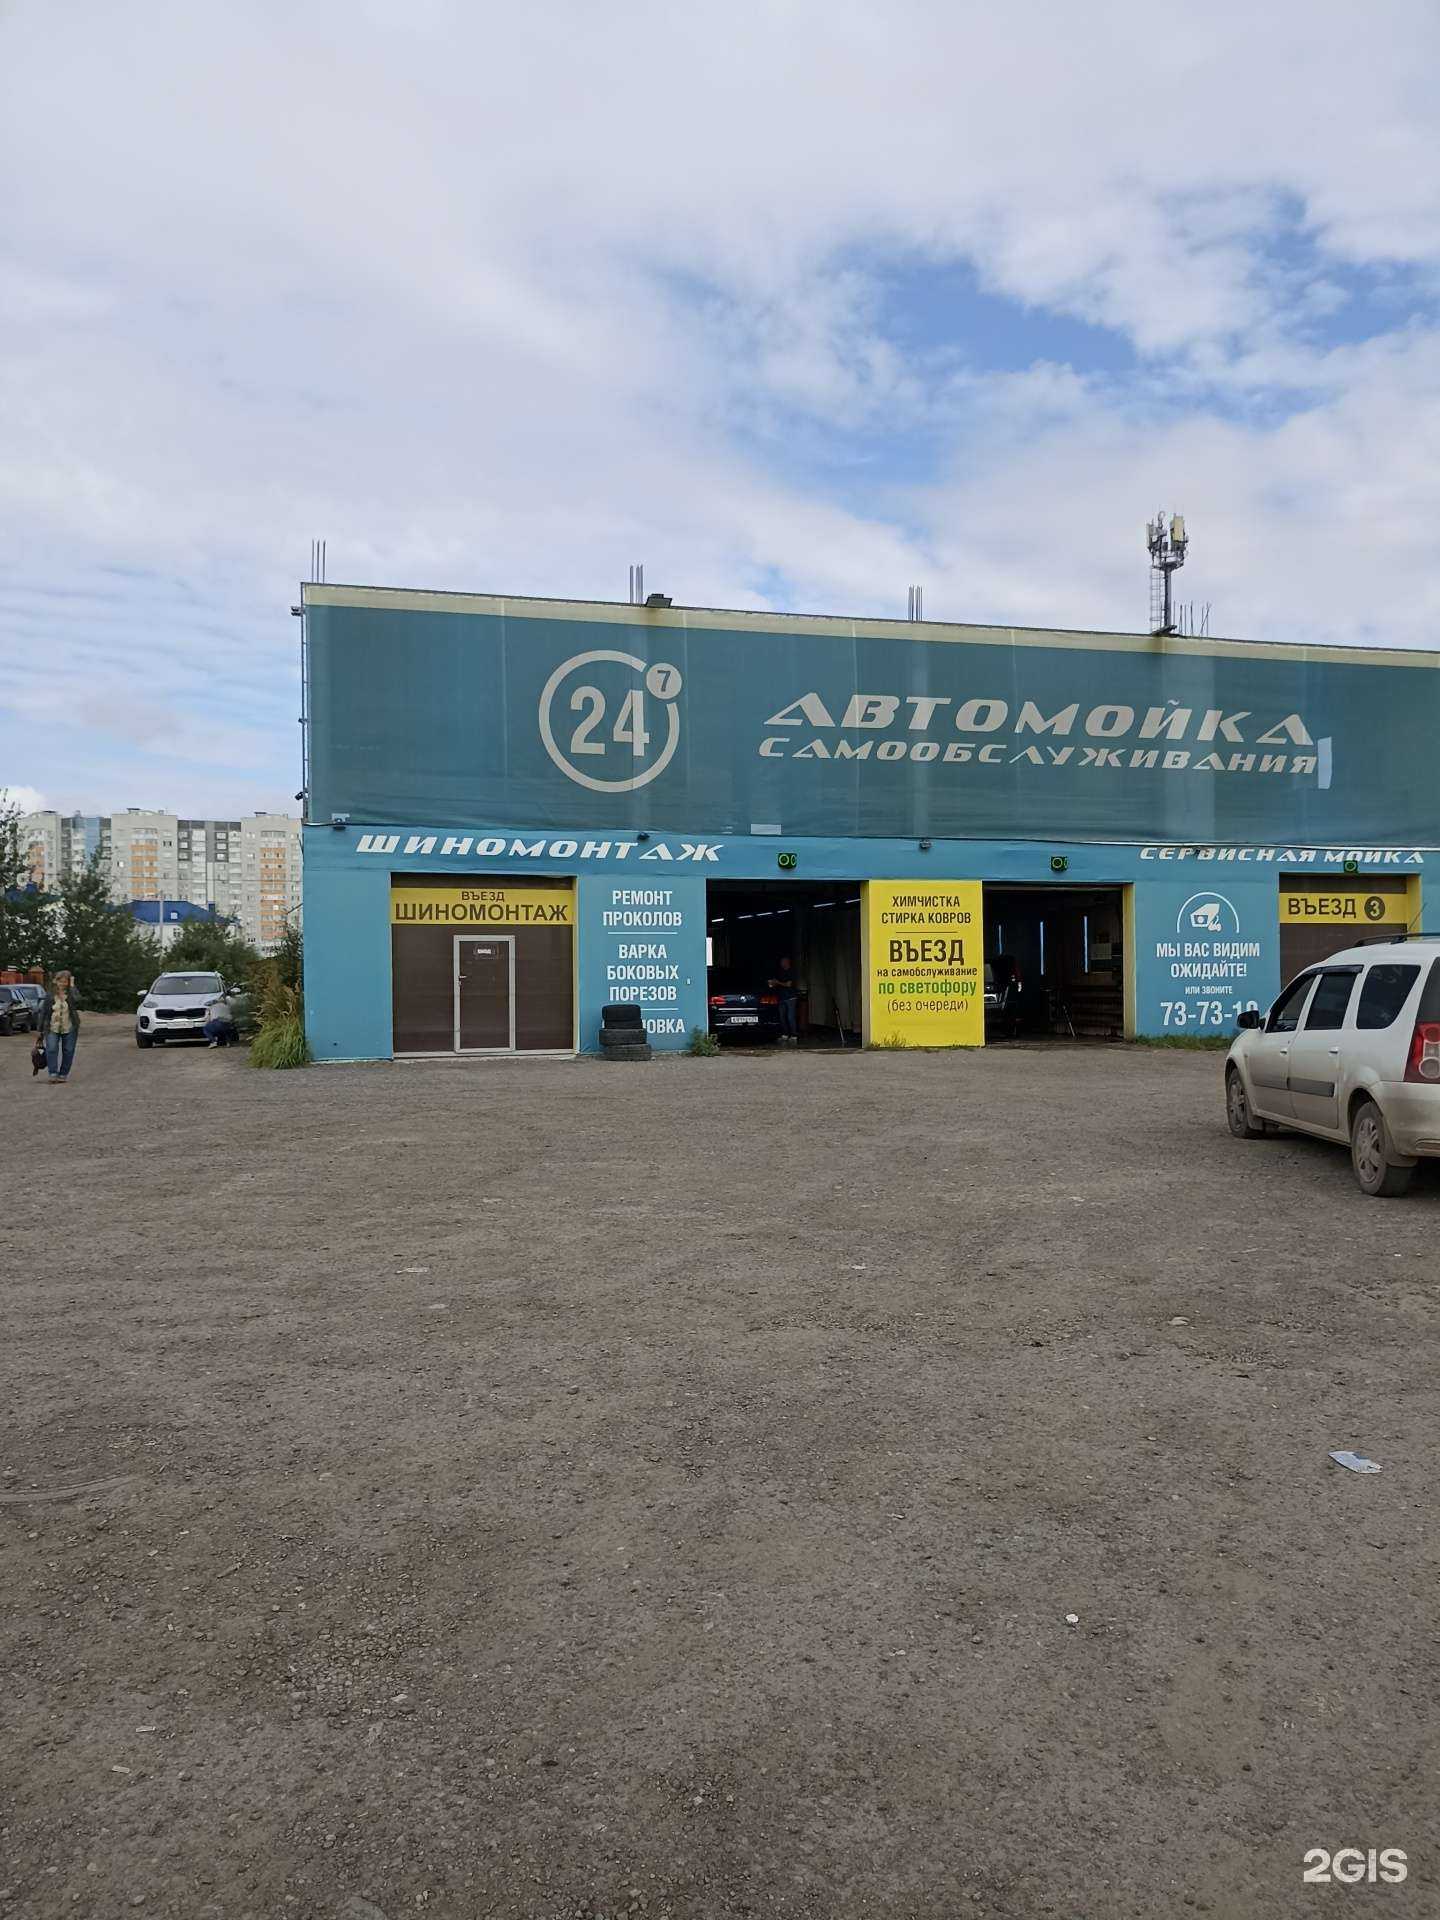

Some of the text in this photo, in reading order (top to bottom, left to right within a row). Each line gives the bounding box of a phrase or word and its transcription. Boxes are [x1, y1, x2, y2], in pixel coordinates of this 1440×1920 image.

[570, 686, 650, 756] 24
[764, 692, 1314, 745] АВТОМОЙКА
[758, 736, 1318, 774] САМООБСЛУЖИВАНИЯ
[355, 834, 723, 862] ШИНОМОНТАЖ
[1139, 846, 1315, 862] СЕРВИСНАЯ
[461, 888, 505, 903] ВЪЕЗД
[612, 889, 673, 906] РЕМОНТ
[892, 895, 960, 907] ХИМЧИСТКА
[396, 904, 568, 922] ШИНОМОНТАЖ
[1287, 898, 1356, 919] ВЪЕЗД
[603, 911, 683, 928] ПРОКОЛОВ
[881, 912, 971, 924] СТИРКА КОВРОВ
[618, 944, 668, 960] ВАРКА
[890, 939, 964, 965] ВЪЕЗД
[1156, 942, 1260, 960] МЫ ВАС ВИДИМ
[607, 965, 680, 982] БОКОВЫХ
[877, 969, 889, 977] на
[1170, 960, 1247, 979] ОЖИДАЙТЕ!
[609, 986, 677, 1002] ПОРЕЗОВ
[879, 979, 977, 996] по светофору
[1185, 986, 1233, 995] ИЛИ ЗВОНИТЕ
[887, 999, 968, 1013] (без очереди)
